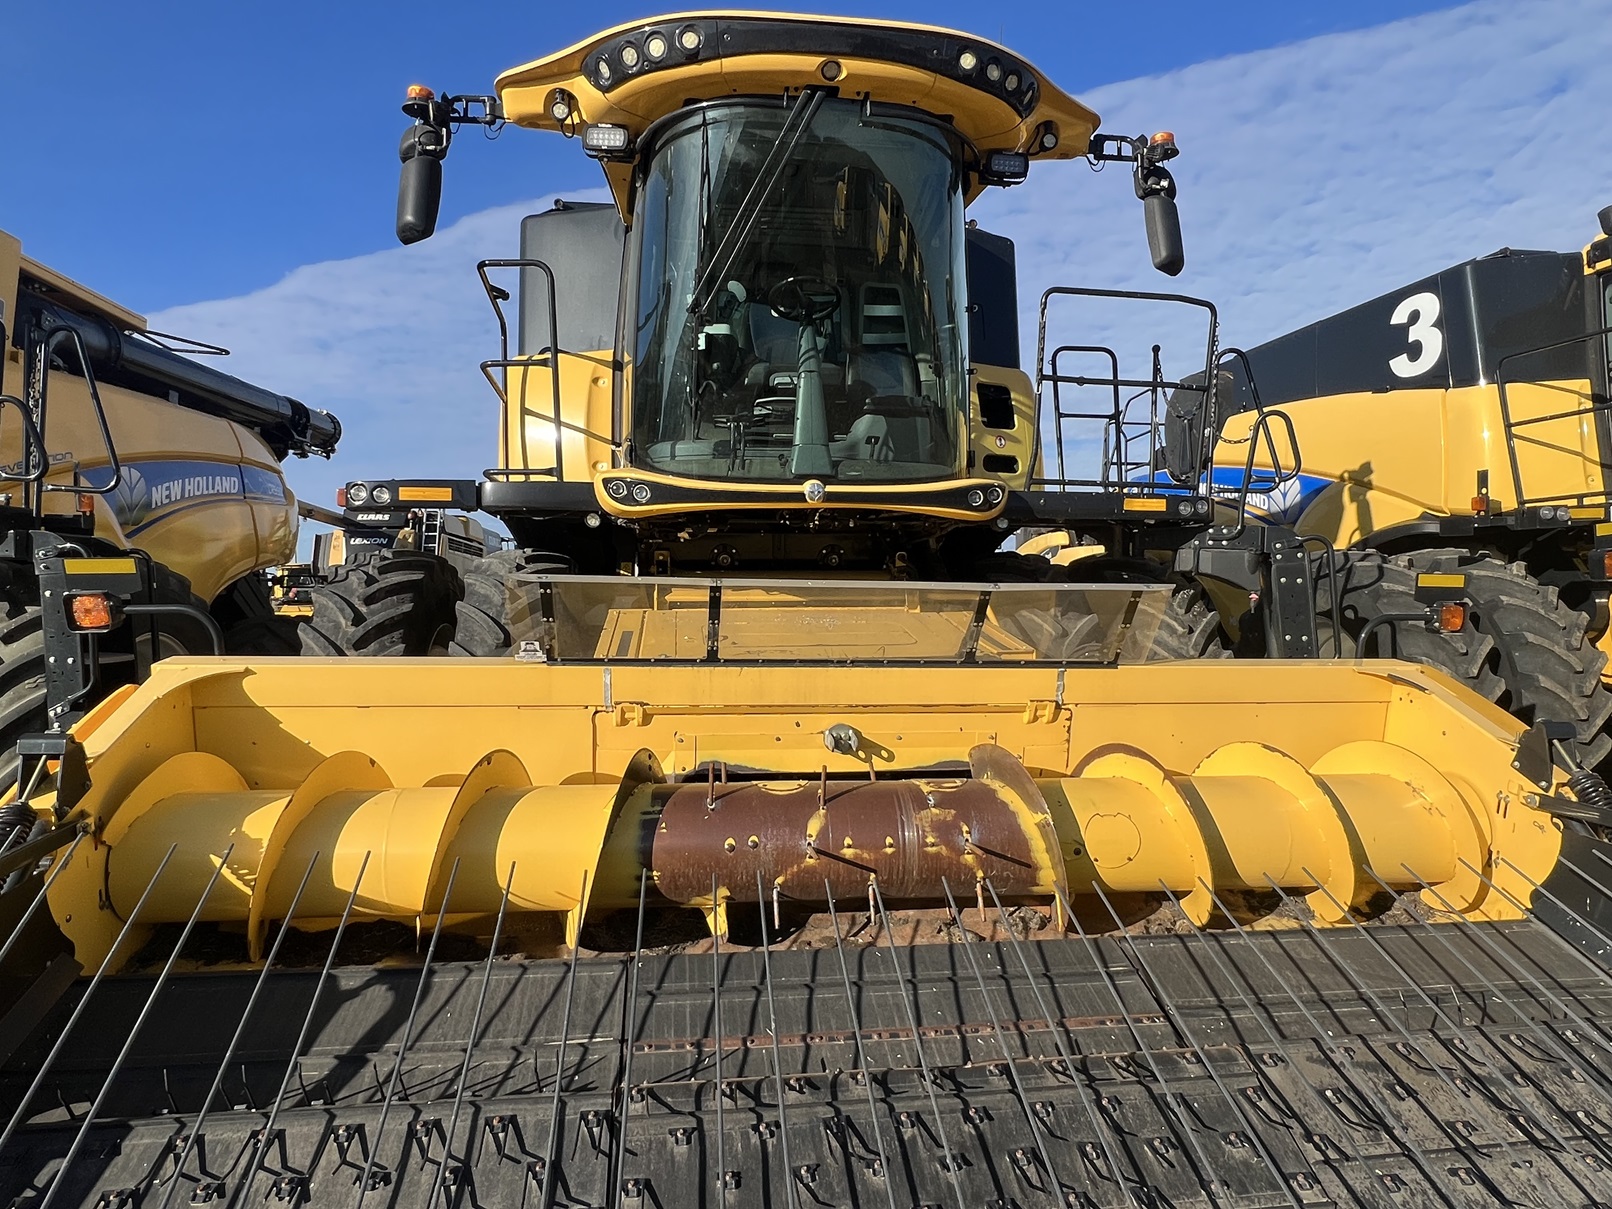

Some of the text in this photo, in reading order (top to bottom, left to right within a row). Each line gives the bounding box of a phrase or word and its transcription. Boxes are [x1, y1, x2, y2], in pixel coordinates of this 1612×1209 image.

[1388, 292, 1443, 378] 3
[151, 479, 183, 509] NEW
[184, 476, 239, 498] HOLLAND
[356, 513, 391, 521] CLAAS
[350, 537, 389, 545] LEXION
